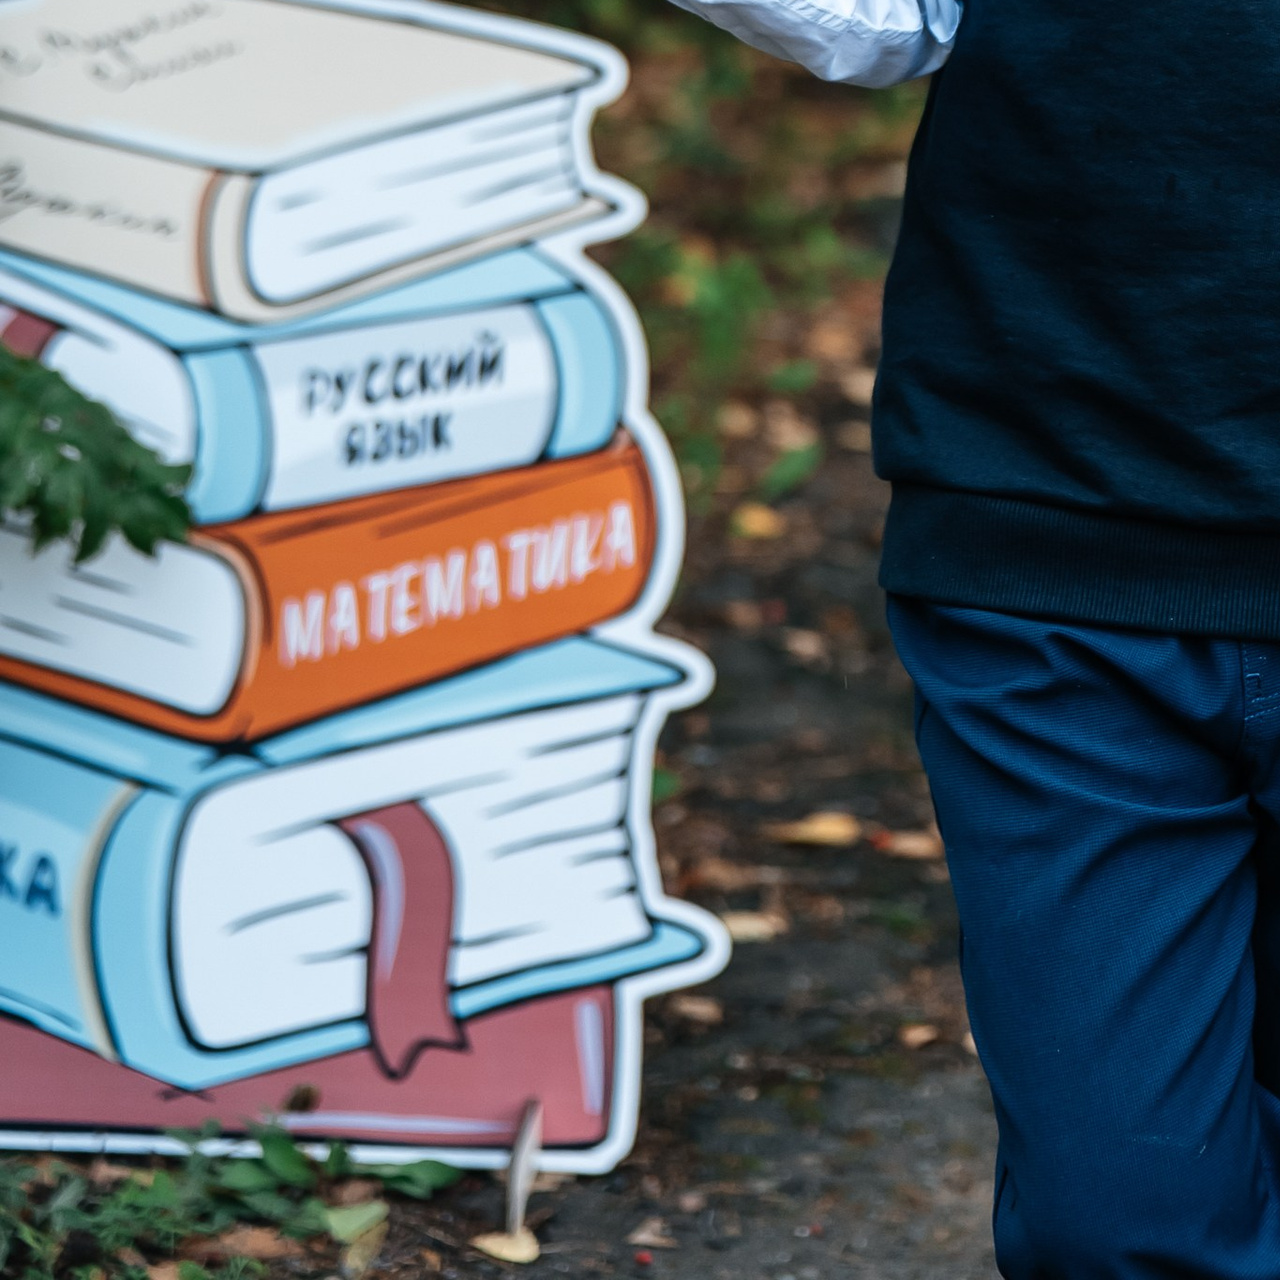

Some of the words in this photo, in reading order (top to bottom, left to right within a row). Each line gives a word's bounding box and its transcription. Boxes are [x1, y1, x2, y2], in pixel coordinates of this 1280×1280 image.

[304, 330, 504, 415] РУССКИЙ
[346, 412, 450, 464] ЯЗЫК
[280, 502, 635, 666] МАТЕМАТИКА
